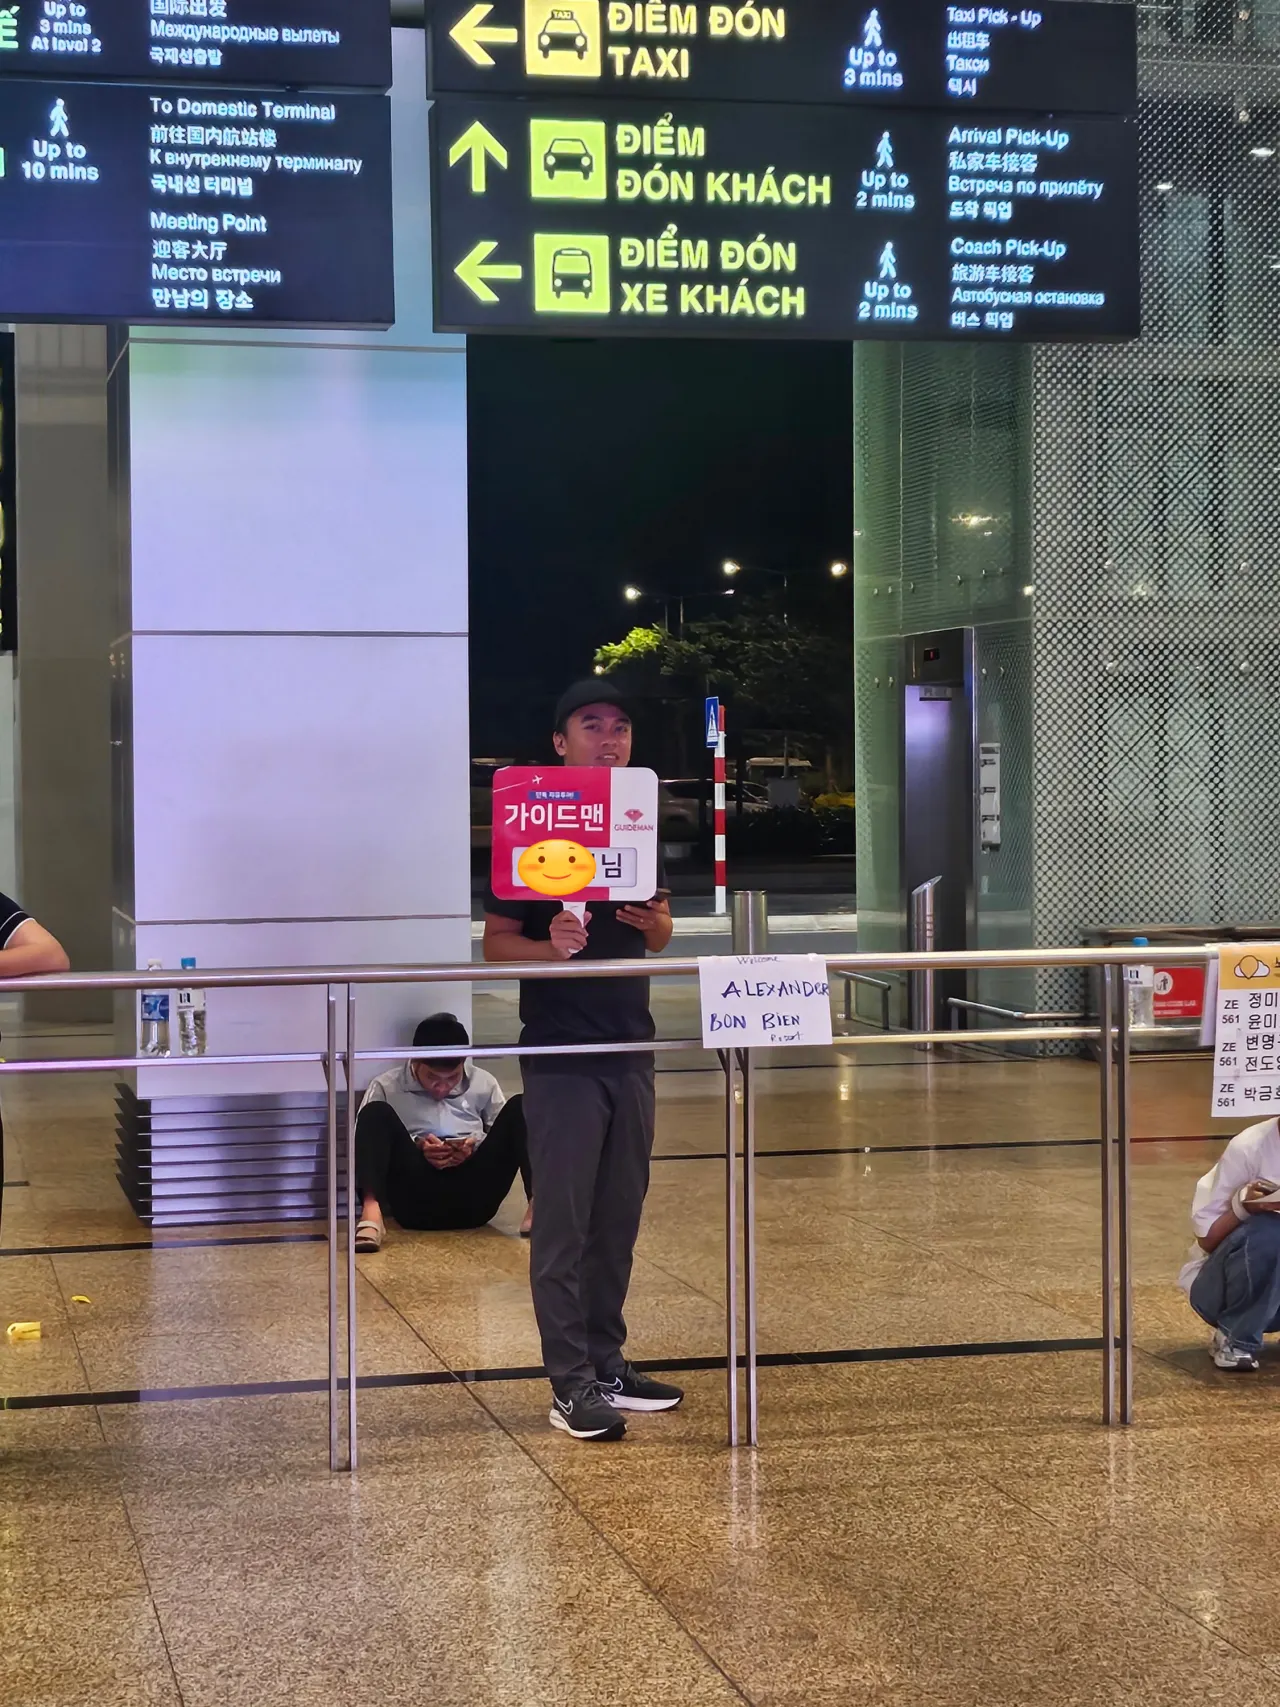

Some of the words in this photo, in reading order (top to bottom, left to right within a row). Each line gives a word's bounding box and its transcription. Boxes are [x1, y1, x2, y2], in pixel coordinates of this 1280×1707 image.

[44, 1, 67, 19] Up
[69, 2, 86, 17] to
[708, 0, 786, 38] ĐÓN
[947, 7, 975, 23] Taxi
[978, 8, 1008, 25] Pick
[1020, 10, 1042, 28] Up
[40, 20, 50, 34] 3
[53, 20, 92, 35] mins
[150, 19, 279, 43] Международные
[282, 27, 340, 44] вылеты
[31, 36, 49, 51] At
[52, 36, 88, 52] level
[91, 39, 102, 53] 2
[948, 31, 990, 49] 出租车
[608, 46, 690, 79] TAXI
[849, 47, 875, 68] Up
[878, 50, 898, 67] to
[947, 55, 989, 73] Такси
[844, 69, 856, 85] 3
[860, 69, 904, 87] mins
[948, 78, 977, 96] 택시
[150, 97, 173, 114] To
[177, 98, 257, 118] Domestic
[261, 101, 336, 121] Terminal
[150, 124, 277, 148] 前往国内航站楼
[615, 112, 706, 158] ĐIỂM
[948, 127, 1002, 146] Arrival
[1005, 129, 1069, 150] Pick-Up
[33, 140, 61, 161] Up
[65, 141, 87, 159] to
[22, 161, 46, 180] 10
[50, 162, 100, 181] mins
[165, 152, 271, 173] внутреннему
[275, 156, 363, 175] терминалу
[949, 152, 1038, 173] 私家车接客
[151, 173, 200, 194] 국내선
[203, 175, 253, 196] 터미널
[617, 163, 694, 202] ĐÓN
[706, 166, 831, 206] KHÁCH
[861, 170, 886, 191] Up
[890, 172, 909, 188] to
[948, 176, 1013, 195] Встреча
[1016, 180, 1037, 194] по
[1039, 178, 1103, 199] прилёту
[856, 192, 868, 208] 2
[872, 191, 915, 209] mins
[949, 201, 979, 219] 도착
[983, 201, 1013, 220] 픽업
[150, 212, 218, 235] Meeting
[222, 213, 267, 233] Point
[152, 240, 227, 261] 迎客大厅
[619, 223, 708, 271] ĐIỂM
[720, 234, 797, 272] ĐÓN
[951, 237, 1001, 256] Coach
[1004, 239, 1067, 260] Pick-Up
[152, 264, 208, 282] Место
[211, 267, 281, 286] встречи
[952, 264, 1034, 284] 旅游车接客
[152, 289, 209, 309] 만남의
[215, 290, 254, 309] 장소
[620, 282, 667, 314] XE
[680, 278, 805, 317] KHÁCH
[864, 281, 889, 301] Up
[893, 283, 912, 298] to
[952, 287, 1032, 307] Автобусная
[1034, 291, 1105, 306] остановка
[859, 303, 871, 319] 2
[875, 303, 918, 320] mins
[952, 311, 980, 327] 버스
[985, 311, 1014, 329] 픽업
[505, 802, 604, 832] 가이드맨
[613, 823, 654, 832] GUIDEMAN
[1224, 999, 1239, 1010] ZE
[710, 1013, 747, 1032] BON
[1222, 1014, 1240, 1024] 561
[1248, 1013, 1280, 1030] 윤미
[1222, 1042, 1236, 1052] ZE
[1246, 1033, 1280, 1051] 변명
[1219, 1056, 1238, 1067] 561
[1219, 1083, 1235, 1093] ZE
[1217, 1097, 1235, 1107] 561
